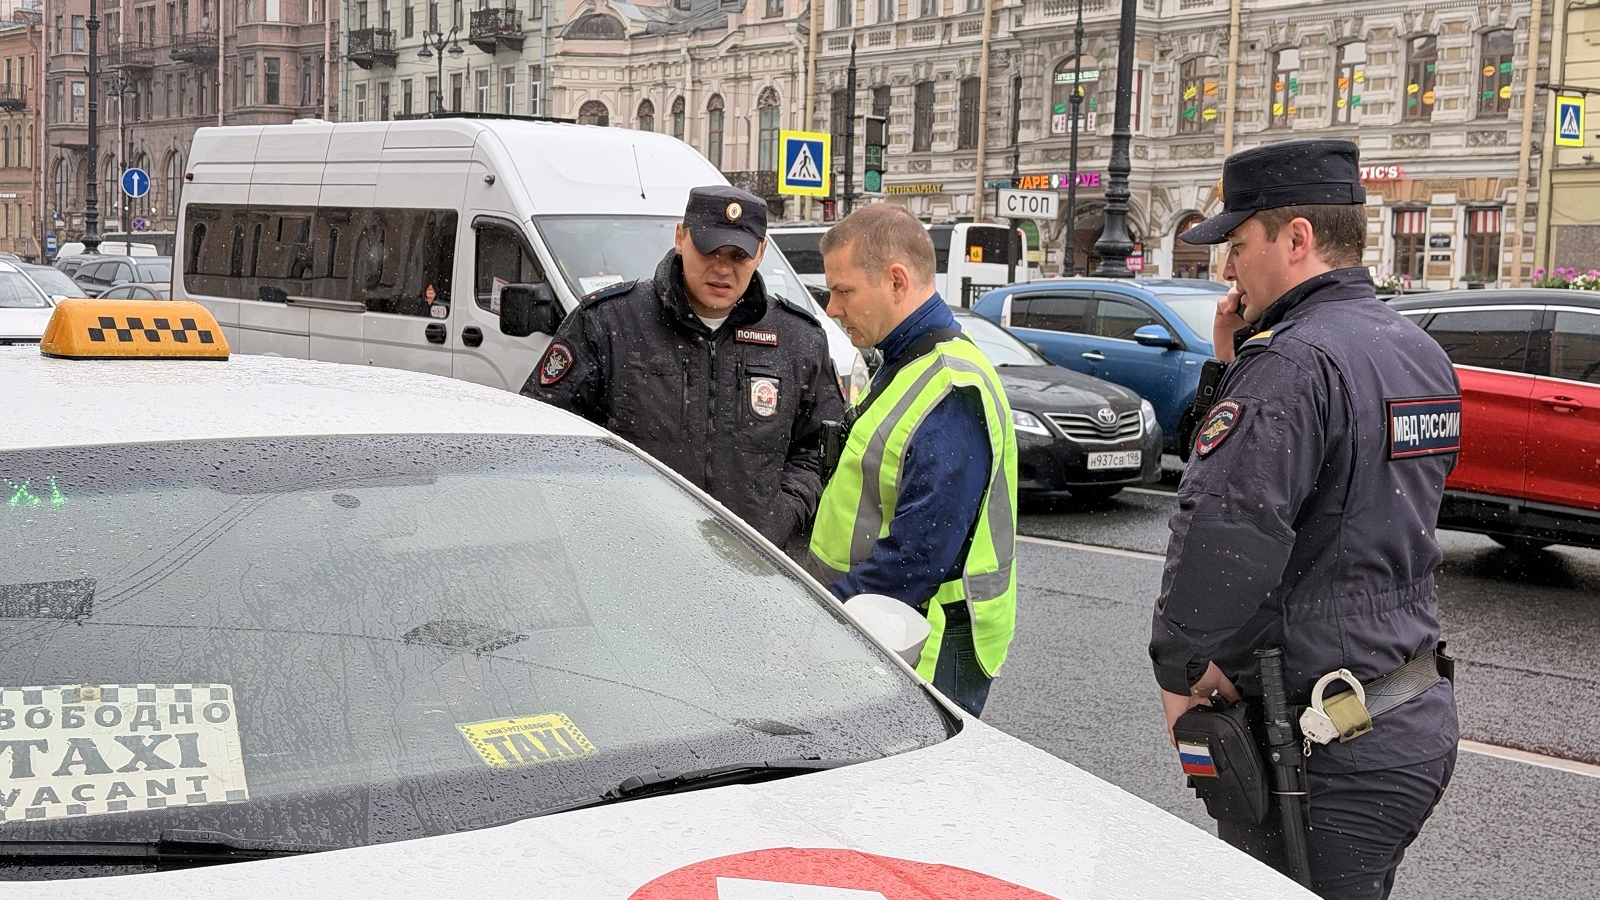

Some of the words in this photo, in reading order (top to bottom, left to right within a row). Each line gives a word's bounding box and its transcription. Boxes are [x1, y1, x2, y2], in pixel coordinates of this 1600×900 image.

[884, 184, 943, 195] АНТИКВАРИАТ
[1007, 194, 1050, 214] СТОП
[738, 330, 777, 342] ПОЛИЦИЯ
[1393, 415, 1419, 446] МВД
[1420, 412, 1460, 440] РОССИИ
[0, 732, 207, 779] TAXI
[481, 727, 581, 763] TAXI
[0, 775, 209, 807] VACANT
